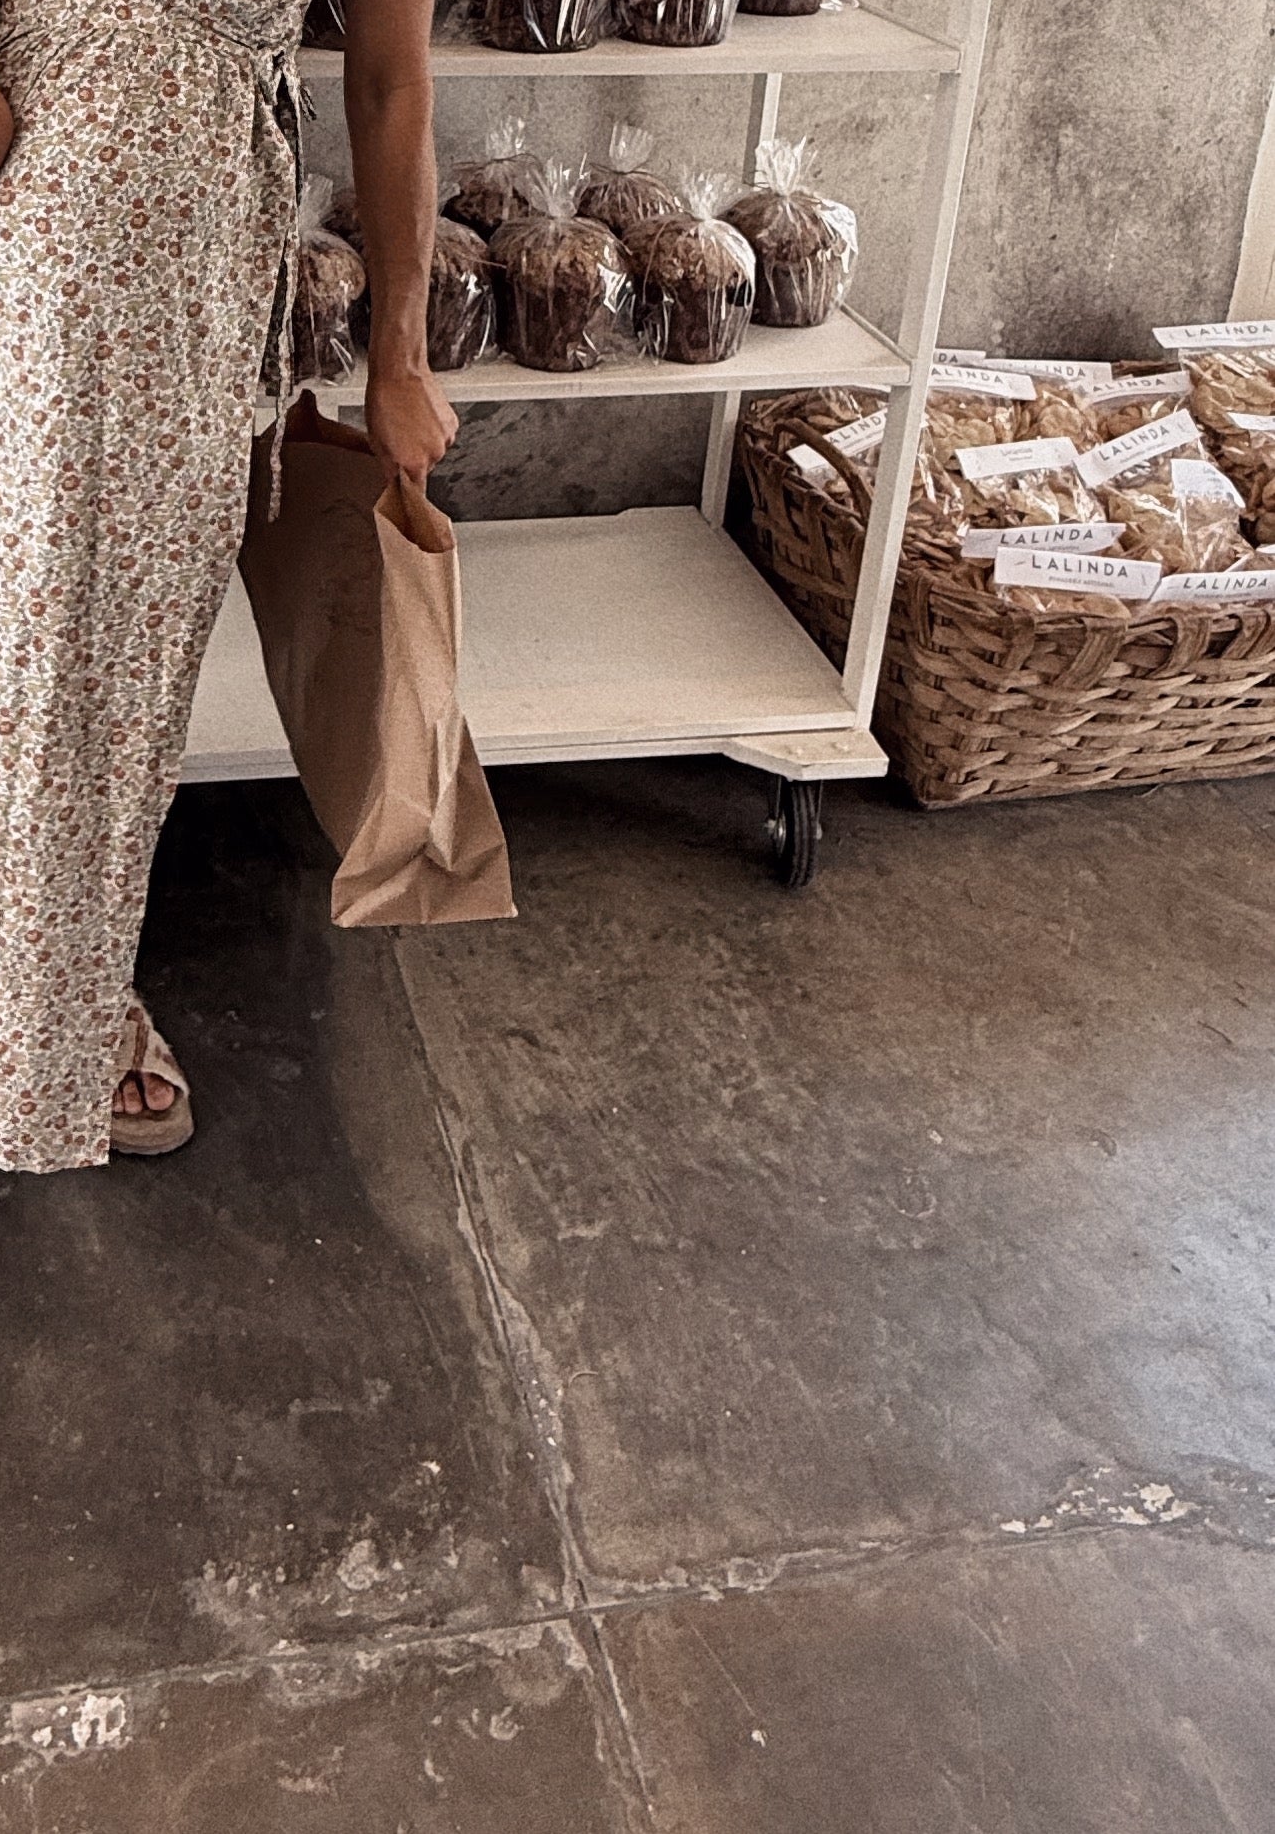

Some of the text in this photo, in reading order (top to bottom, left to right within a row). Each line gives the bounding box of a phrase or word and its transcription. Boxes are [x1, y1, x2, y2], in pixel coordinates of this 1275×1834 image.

[1185, 324, 1273, 338] LALINDA
[931, 367, 1004, 384] ALINDA
[1092, 378, 1165, 392] ALINDA
[1098, 424, 1170, 462] LALINDA
[1000, 529, 1094, 545] LALINDA
[1032, 554, 1129, 578] LALINDA
[1183, 576, 1268, 590] LALINDA
